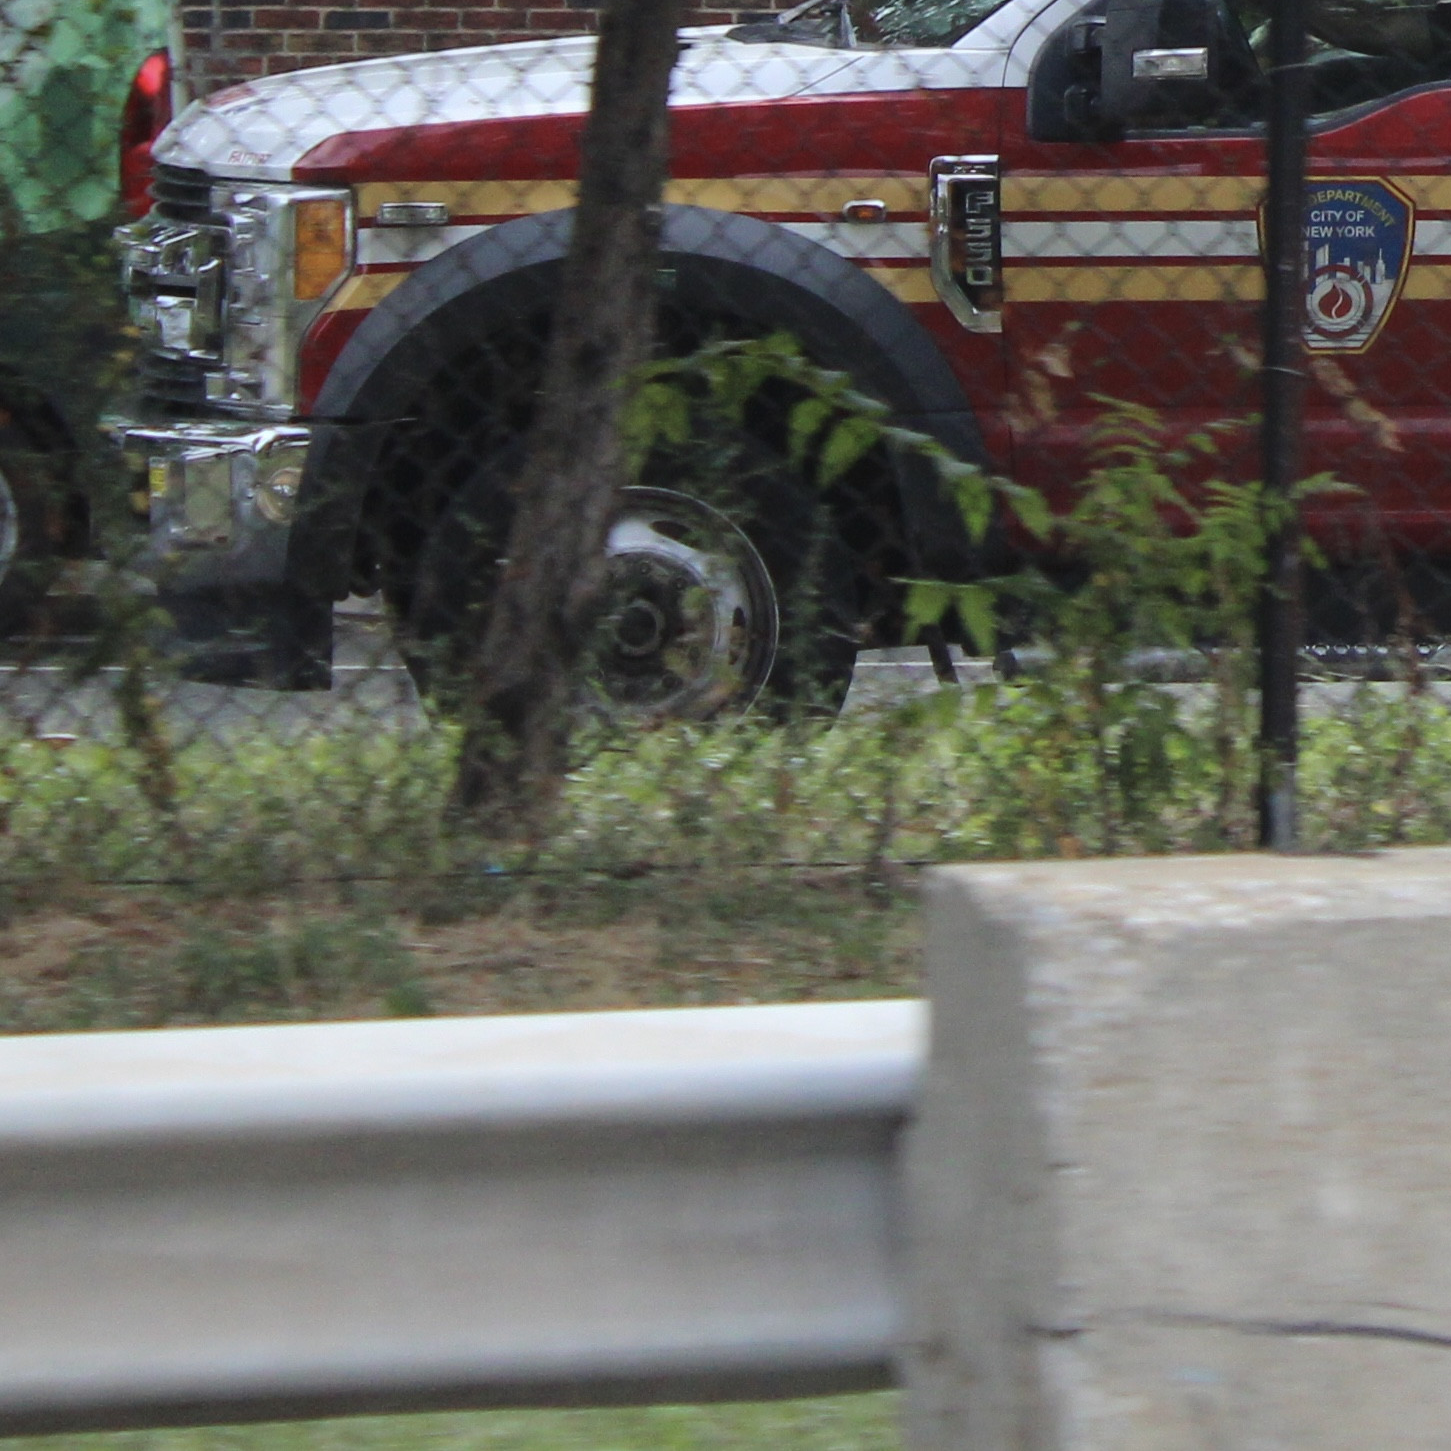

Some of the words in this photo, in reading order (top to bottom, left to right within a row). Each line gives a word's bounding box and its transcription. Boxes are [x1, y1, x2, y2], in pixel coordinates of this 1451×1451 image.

[1311, 210, 1343, 222] CITY
[1345, 210, 1365, 222] OF
[1336, 226, 1375, 238] YORK
